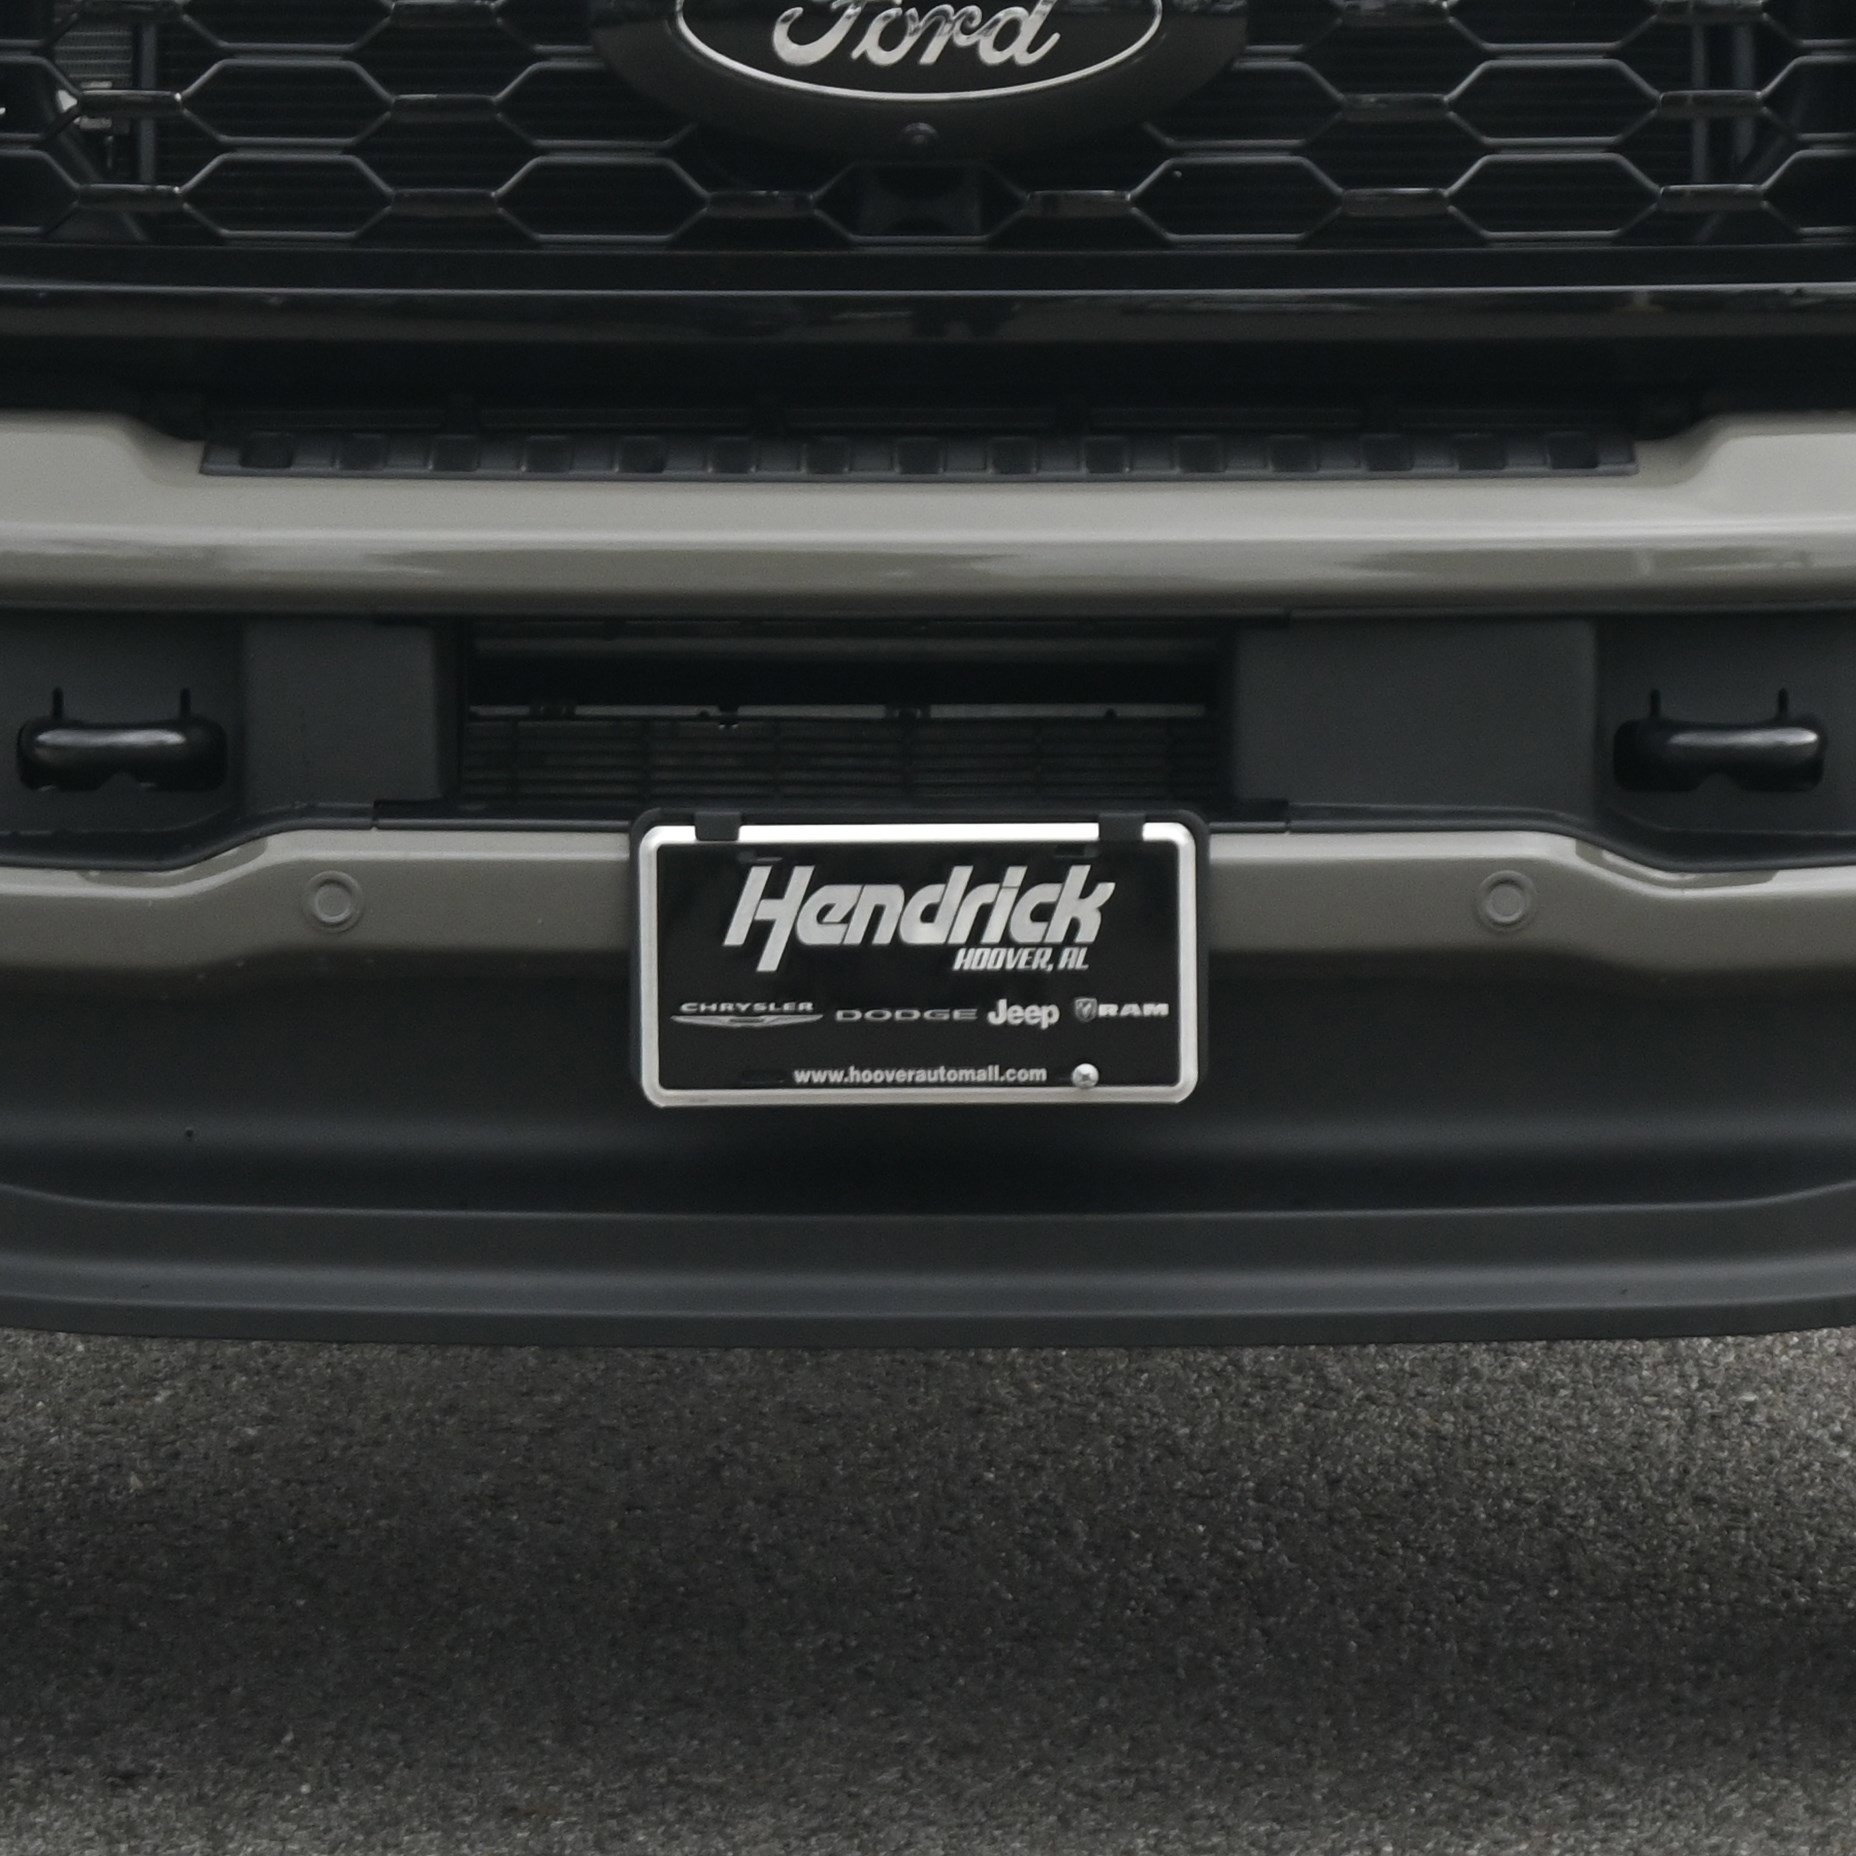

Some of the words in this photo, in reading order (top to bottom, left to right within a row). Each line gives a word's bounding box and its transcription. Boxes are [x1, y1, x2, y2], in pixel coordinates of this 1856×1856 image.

[722, 864, 1117, 973] Hendrick
[952, 946, 1055, 973] HOOVER,
[1057, 946, 1090, 971] AL
[679, 1001, 815, 1013] CHRYSLER
[834, 1008, 979, 1022] DODGE
[986, 998, 1061, 1030] Jeep
[1097, 1002, 1171, 1018] RAM
[793, 1064, 1049, 1085] www.hooverautomall.com
